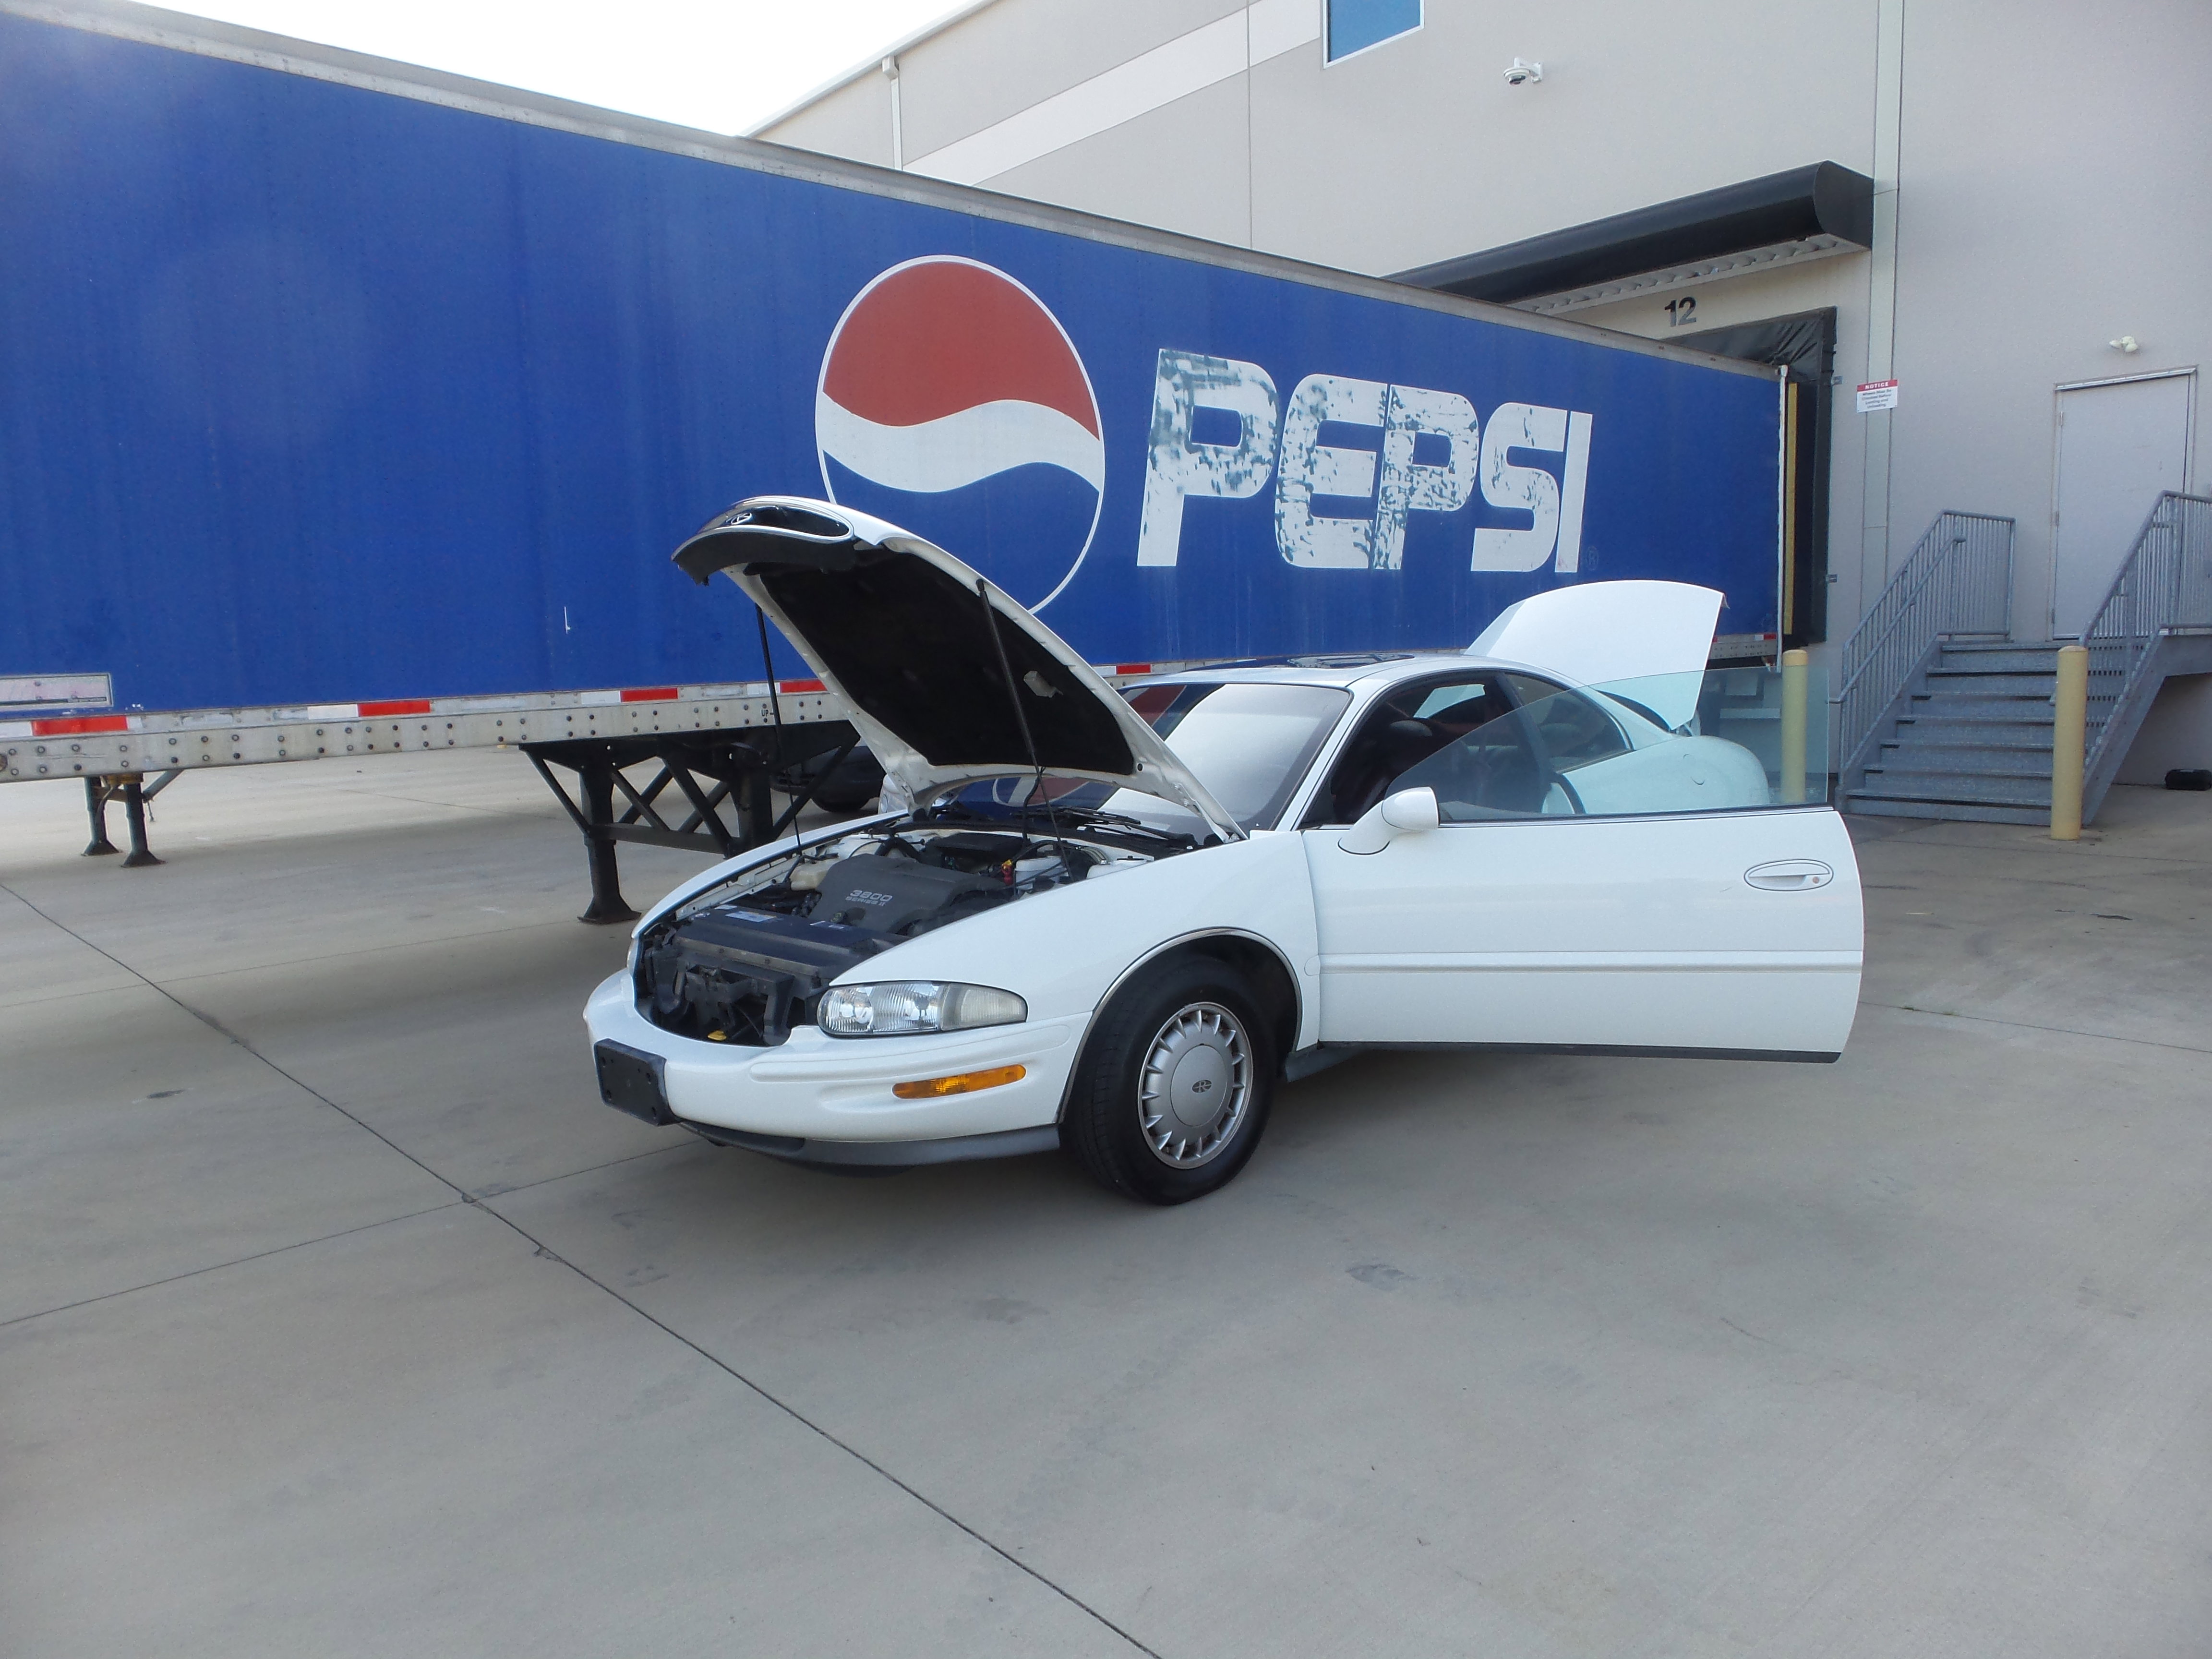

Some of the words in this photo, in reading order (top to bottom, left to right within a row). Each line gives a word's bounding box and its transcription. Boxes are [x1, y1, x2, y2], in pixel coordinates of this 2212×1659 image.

[1664, 297, 1696, 326] 12
[1137, 348, 1593, 573] PEPSI
[845, 896, 878, 904] SERIES
[850, 890, 893, 902] 3800
